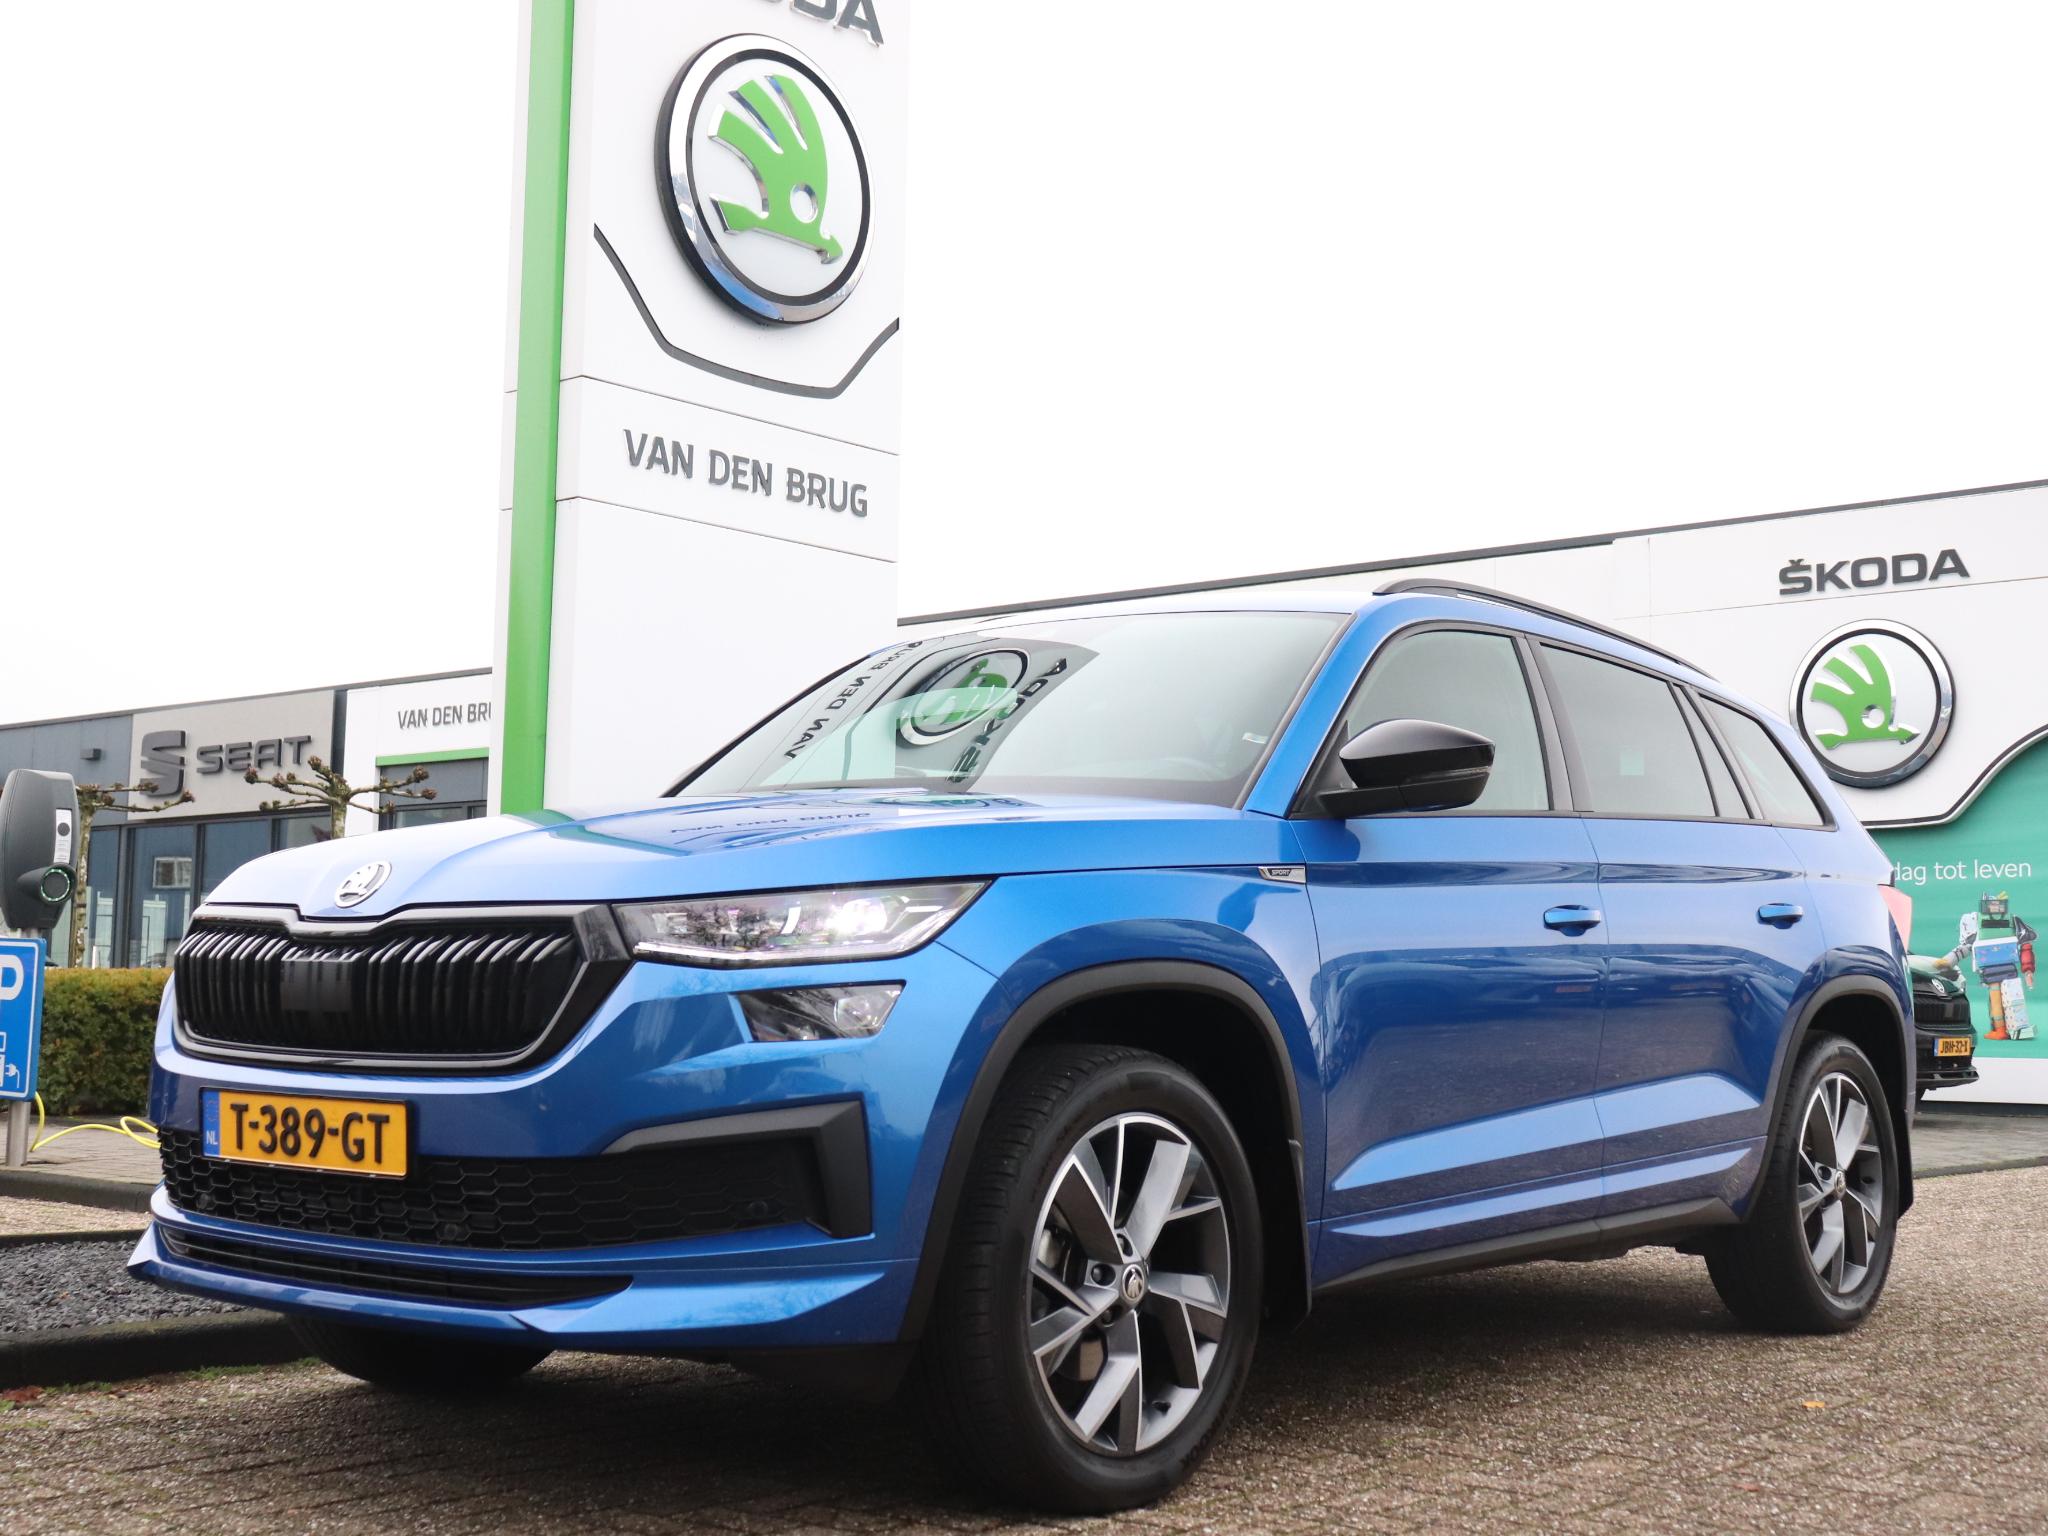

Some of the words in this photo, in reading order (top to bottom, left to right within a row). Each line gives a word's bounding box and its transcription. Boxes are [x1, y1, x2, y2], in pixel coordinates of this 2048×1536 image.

[623, 429, 694, 479] VAN
[708, 449, 773, 497] DEN
[786, 467, 868, 518] BRUG
[1779, 548, 1971, 596] ŠKODA
[398, 708, 428, 729] VAN
[432, 704, 463, 726] DEN
[196, 735, 312, 775] SEAT
[1934, 860, 1967, 880] tot
[1974, 859, 2032, 879] leven
[206, 1130, 219, 1145] NL
[230, 1103, 390, 1165] T-389-GT
